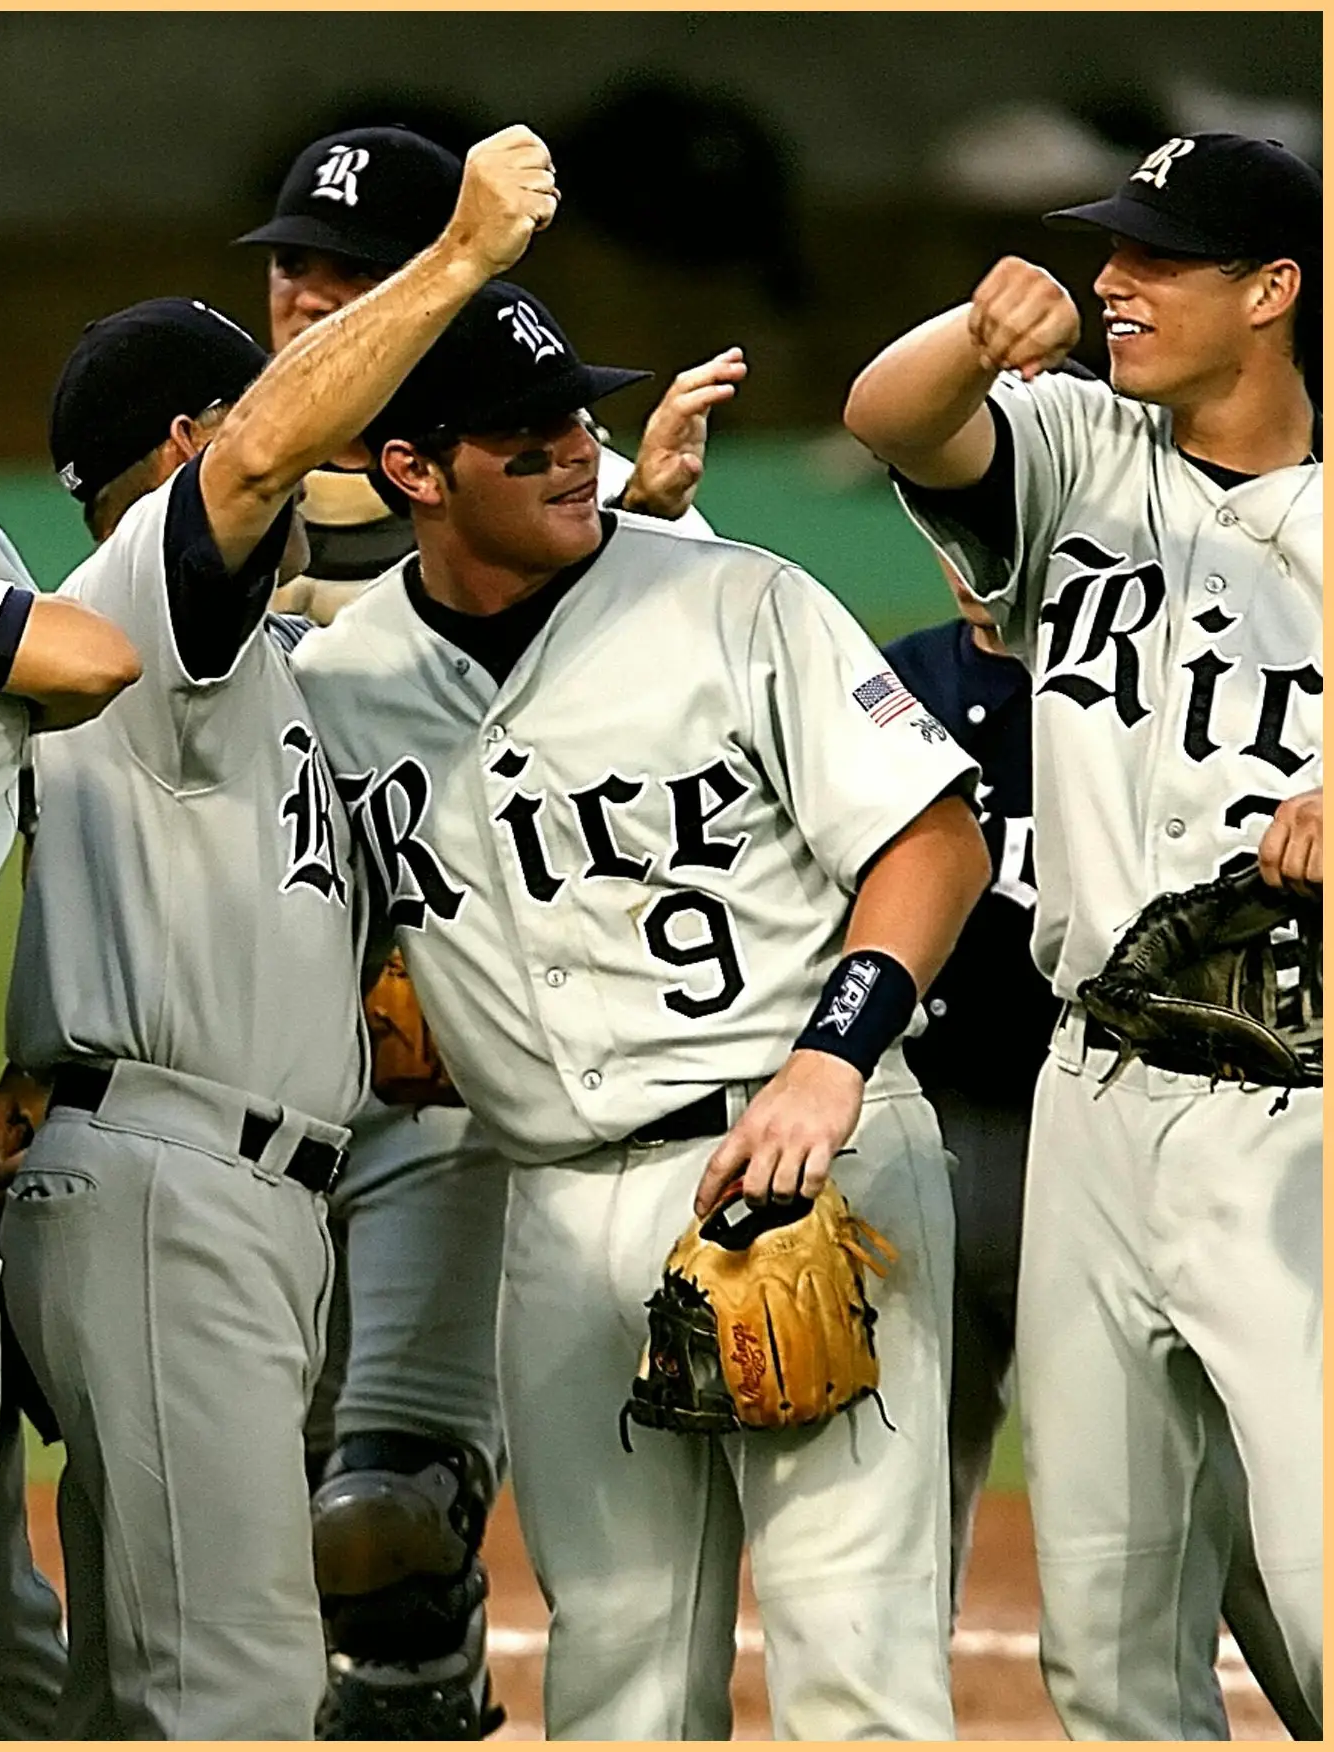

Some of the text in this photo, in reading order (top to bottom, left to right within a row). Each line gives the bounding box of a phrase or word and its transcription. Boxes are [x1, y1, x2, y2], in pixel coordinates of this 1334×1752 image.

[311, 144, 370, 207] R
[1129, 137, 1196, 190] R
[497, 300, 565, 365] R
[333, 744, 756, 932] Rice
[640, 887, 749, 1020] 9
[815, 958, 881, 1037] TPX
